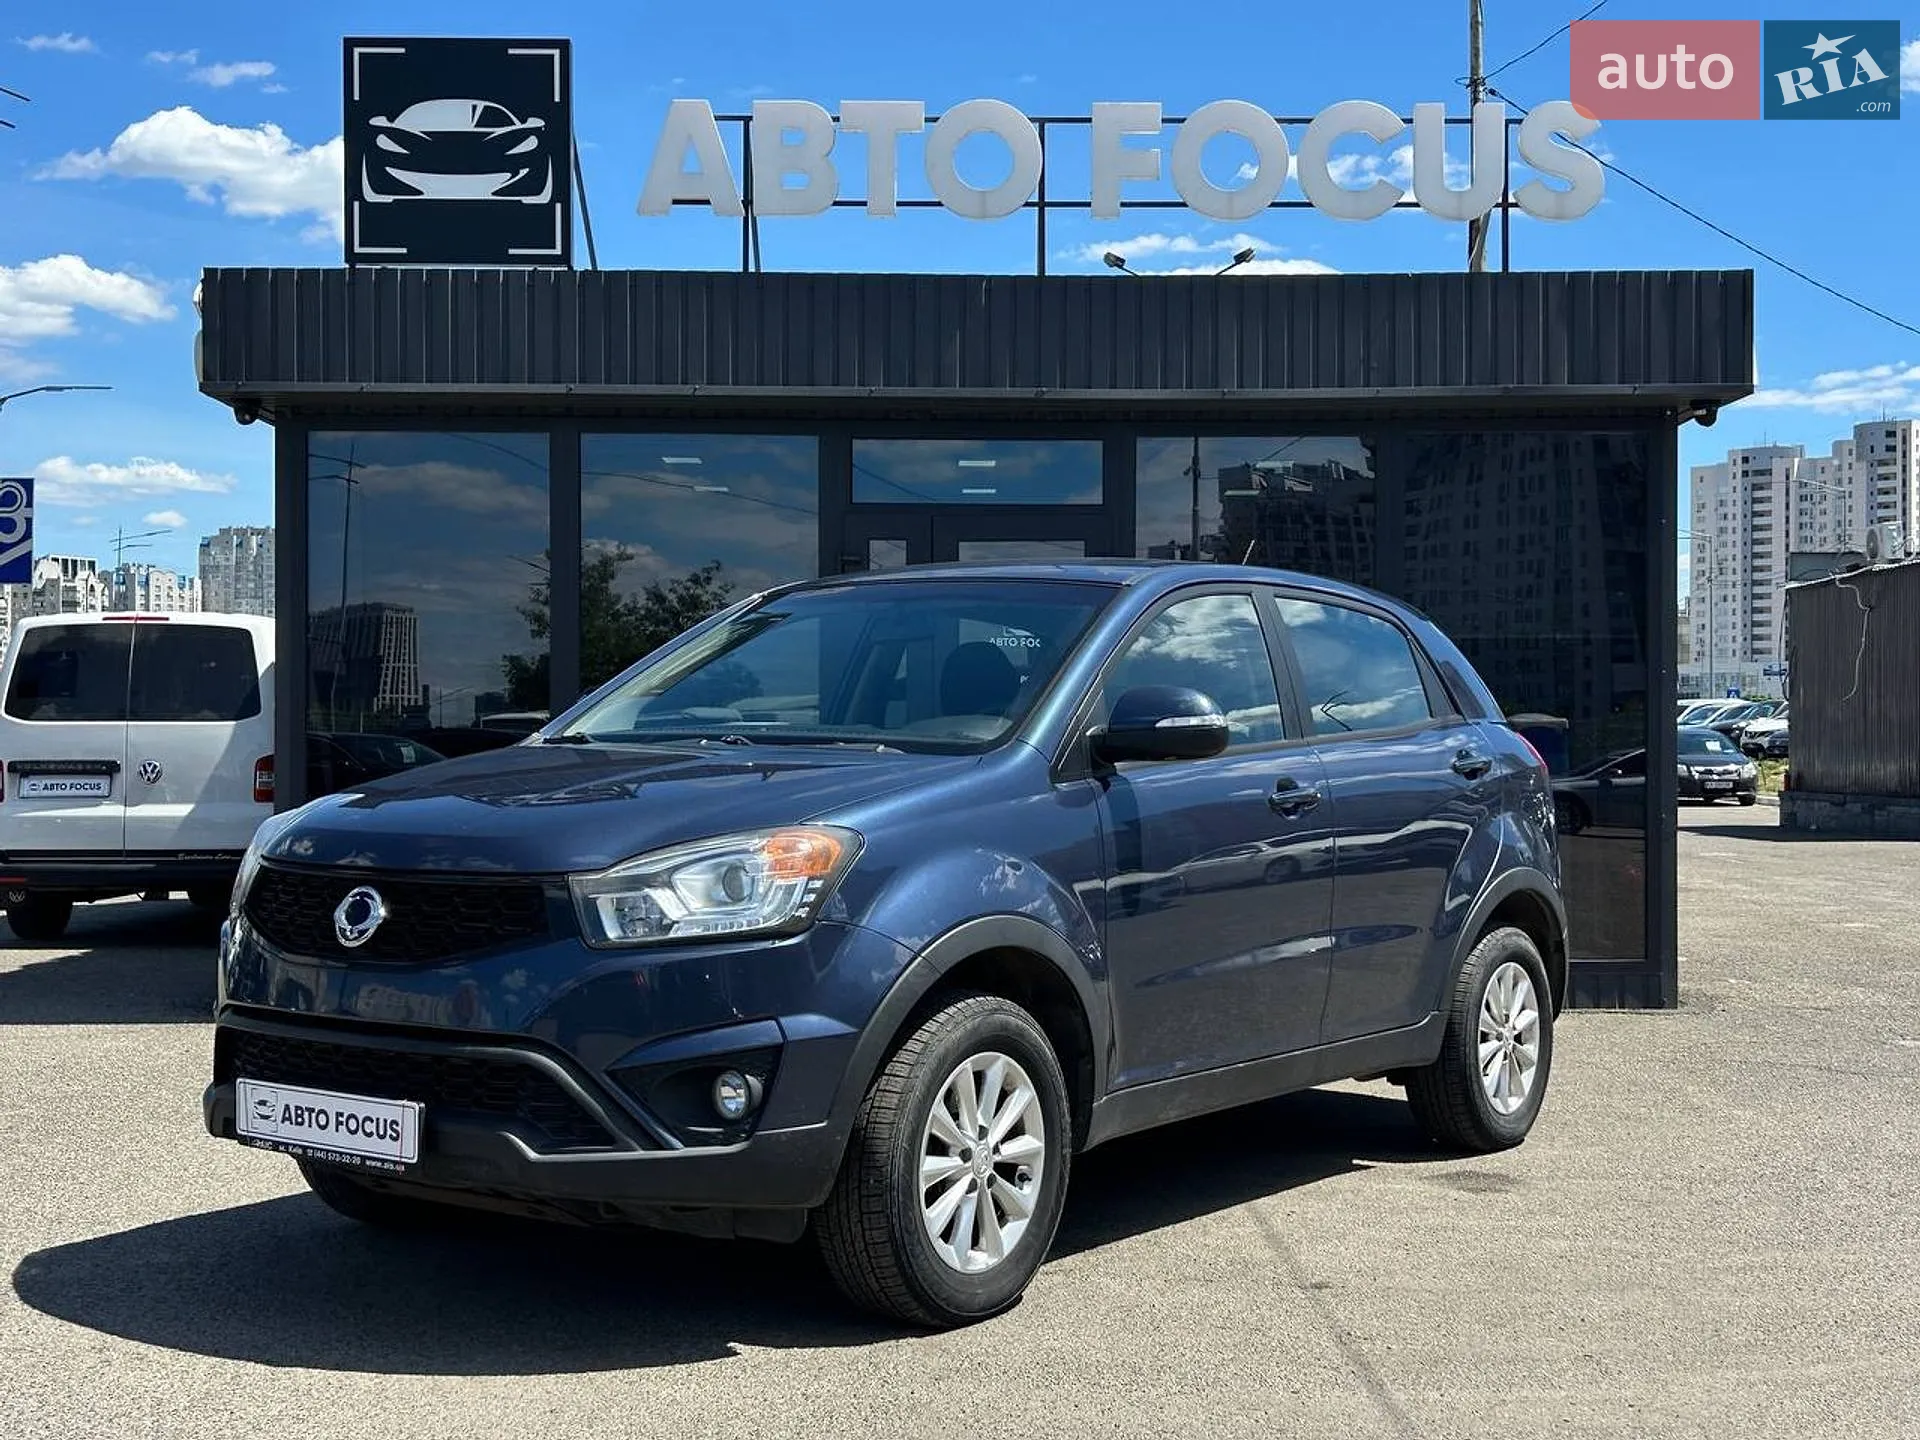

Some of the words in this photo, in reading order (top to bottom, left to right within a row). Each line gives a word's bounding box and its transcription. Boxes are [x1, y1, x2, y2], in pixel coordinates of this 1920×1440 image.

[636, 99, 1044, 219] АВТО
[1089, 98, 1606, 222] FOCUS
[42, 782, 68, 791] АВТО
[69, 782, 102, 791] FOCUS
[280, 1103, 330, 1131] АВТО
[334, 1111, 401, 1142] FOCUS
